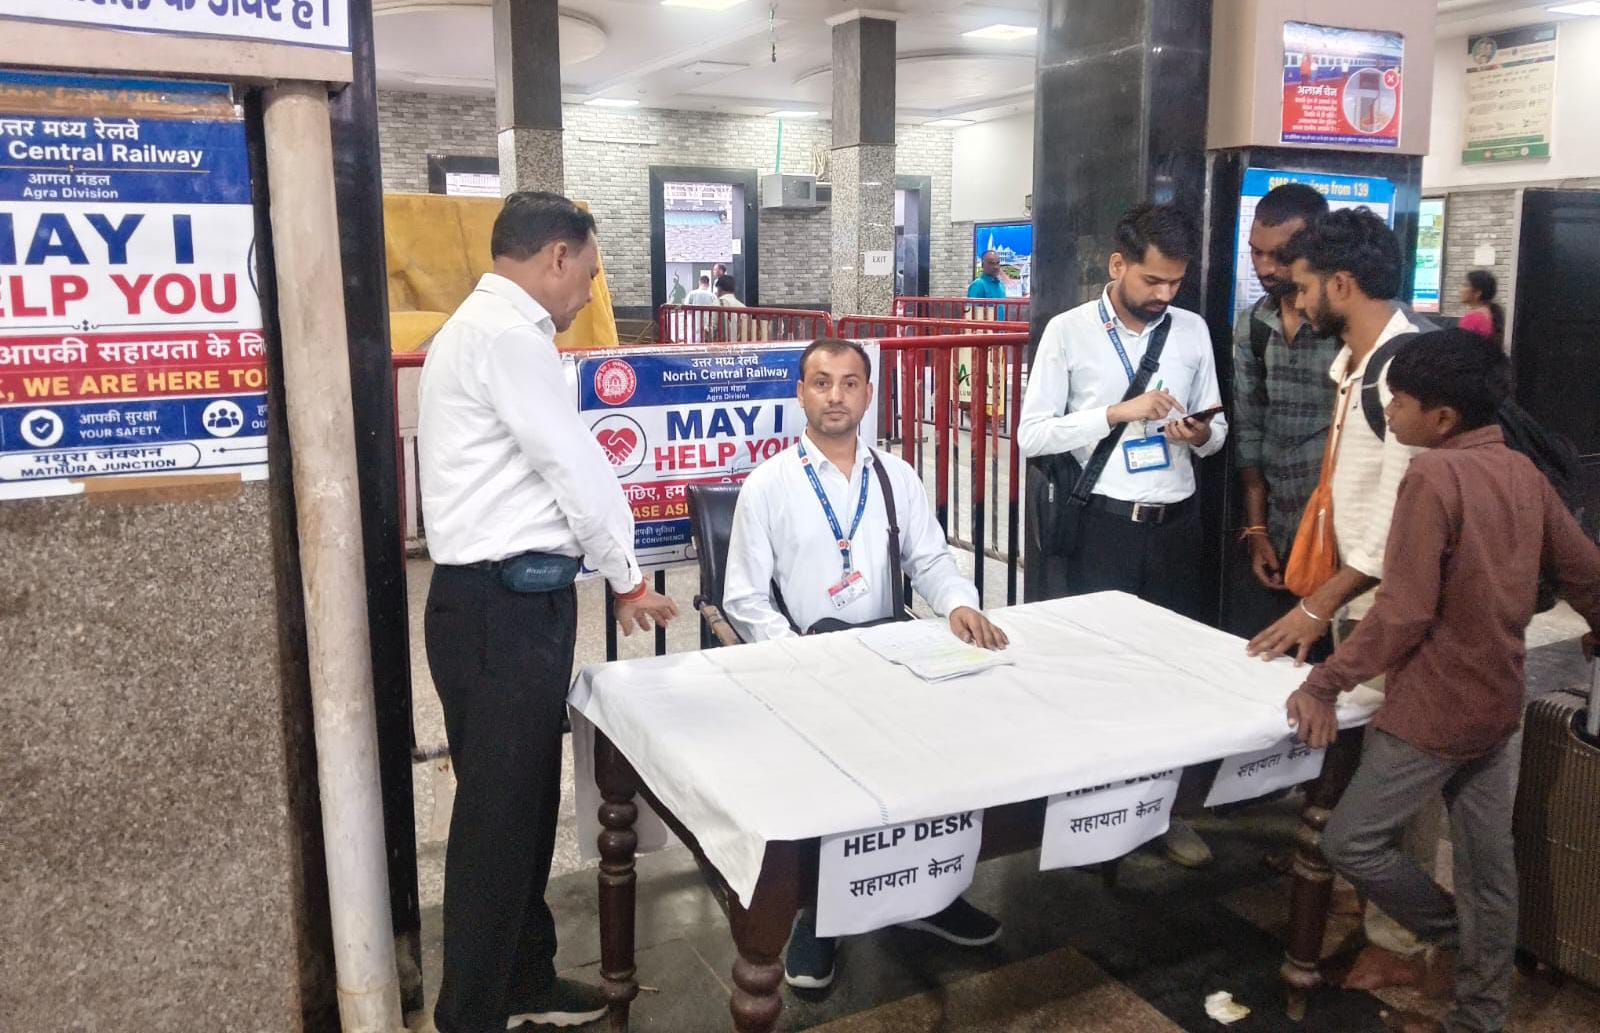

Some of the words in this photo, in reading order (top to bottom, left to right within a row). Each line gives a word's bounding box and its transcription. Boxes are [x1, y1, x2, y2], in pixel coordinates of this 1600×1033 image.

[42, 120, 87, 138] मध्य
[94, 117, 140, 140] रेलवे
[8, 140, 104, 161] Central
[111, 143, 203, 168] Railway
[28, 173, 71, 185] आगरा
[75, 172, 111, 186] मंडल
[1331, 180, 1351, 197] from
[1353, 182, 1370, 198] 139
[23, 187, 58, 200] Agra
[62, 187, 119, 199] Division
[172, 214, 194, 264] I
[872, 255, 887, 263] EXIT
[109, 273, 238, 315] YOU
[96, 340, 199, 364] सहायता
[206, 333, 231, 358] के
[691, 357, 712, 368] उत्तर
[715, 356, 735, 367] मध्य
[737, 353, 759, 366] रेलवे
[23, 376, 70, 398] WE
[79, 373, 138, 395] ARE
[147, 370, 220, 392] HERE
[228, 368, 263, 388] TO
[663, 369, 697, 381] North
[700, 367, 743, 380] Central
[746, 367, 788, 379] Railway
[706, 394, 722, 402] Agra
[80, 410, 120, 424] आपकी
[125, 410, 158, 426] सुरक्षा
[666, 405, 762, 441] MAY
[774, 404, 783, 433] I
[79, 427, 112, 439] YOUR
[115, 425, 161, 437] SAFETY
[34, 451, 88, 468] मथुरा
[654, 441, 737, 471] HELP
[21, 463, 97, 477] MATHURA
[101, 459, 176, 472] JUNCTION
[1237, 752, 1283, 777] सहायता
[1070, 808, 1128, 833] सहायता
[844, 827, 906, 857] HELP
[914, 811, 973, 841] DESK
[849, 867, 919, 897] सहायता
[928, 854, 964, 879] केन्द्र
